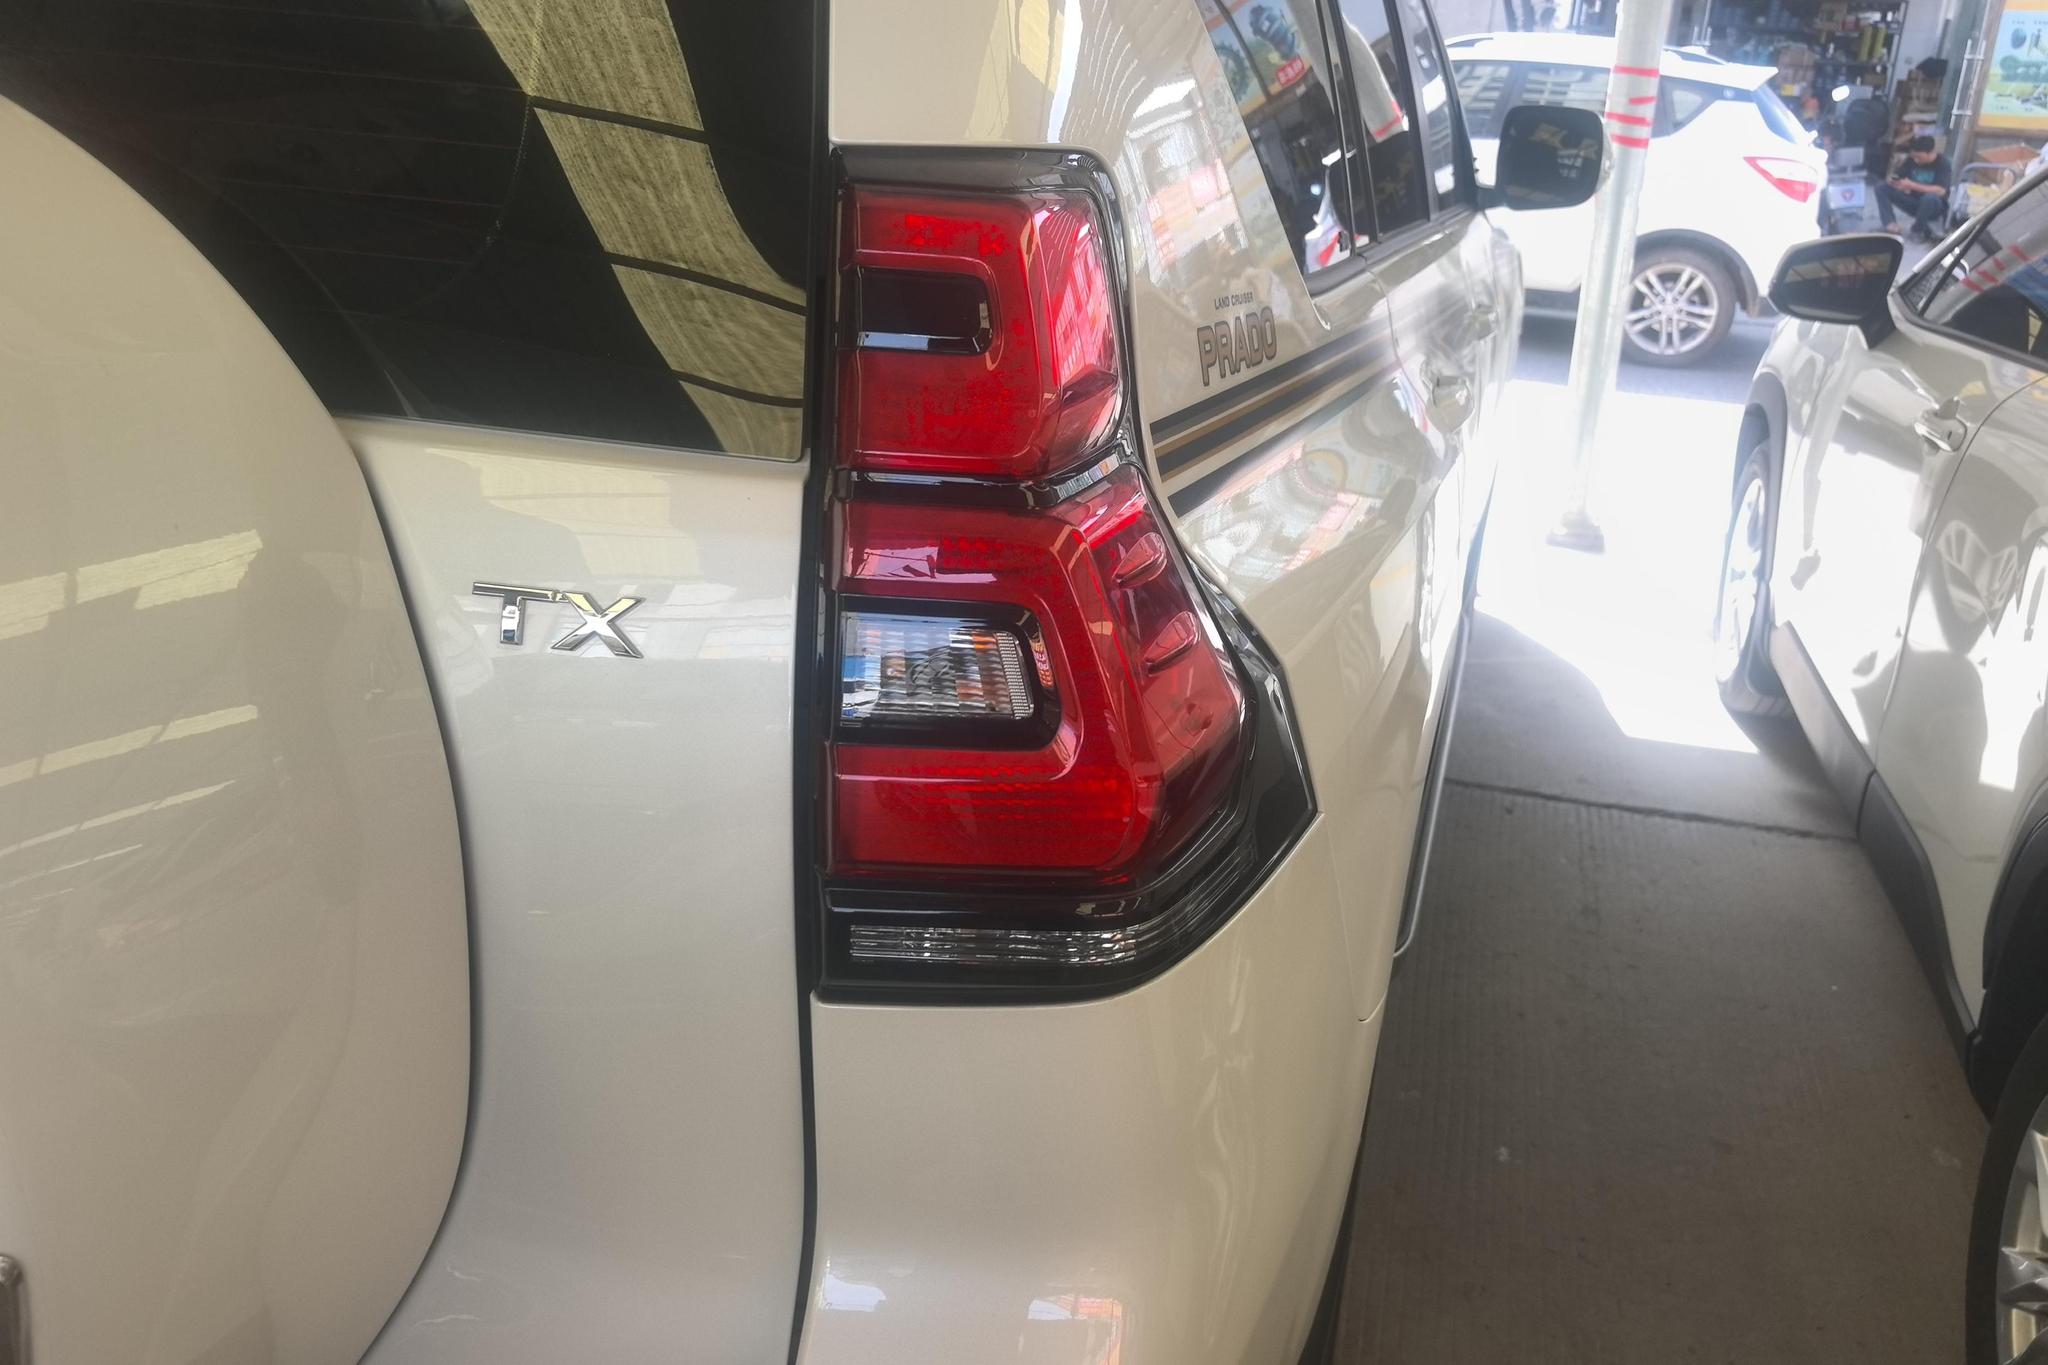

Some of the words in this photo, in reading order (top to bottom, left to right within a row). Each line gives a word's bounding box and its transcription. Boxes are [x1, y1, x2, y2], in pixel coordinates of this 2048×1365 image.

[1214, 296, 1230, 310] LAND
[1231, 291, 1254, 306] CRUISER
[1197, 306, 1278, 387] PRADO
[472, 581, 646, 658] TX
